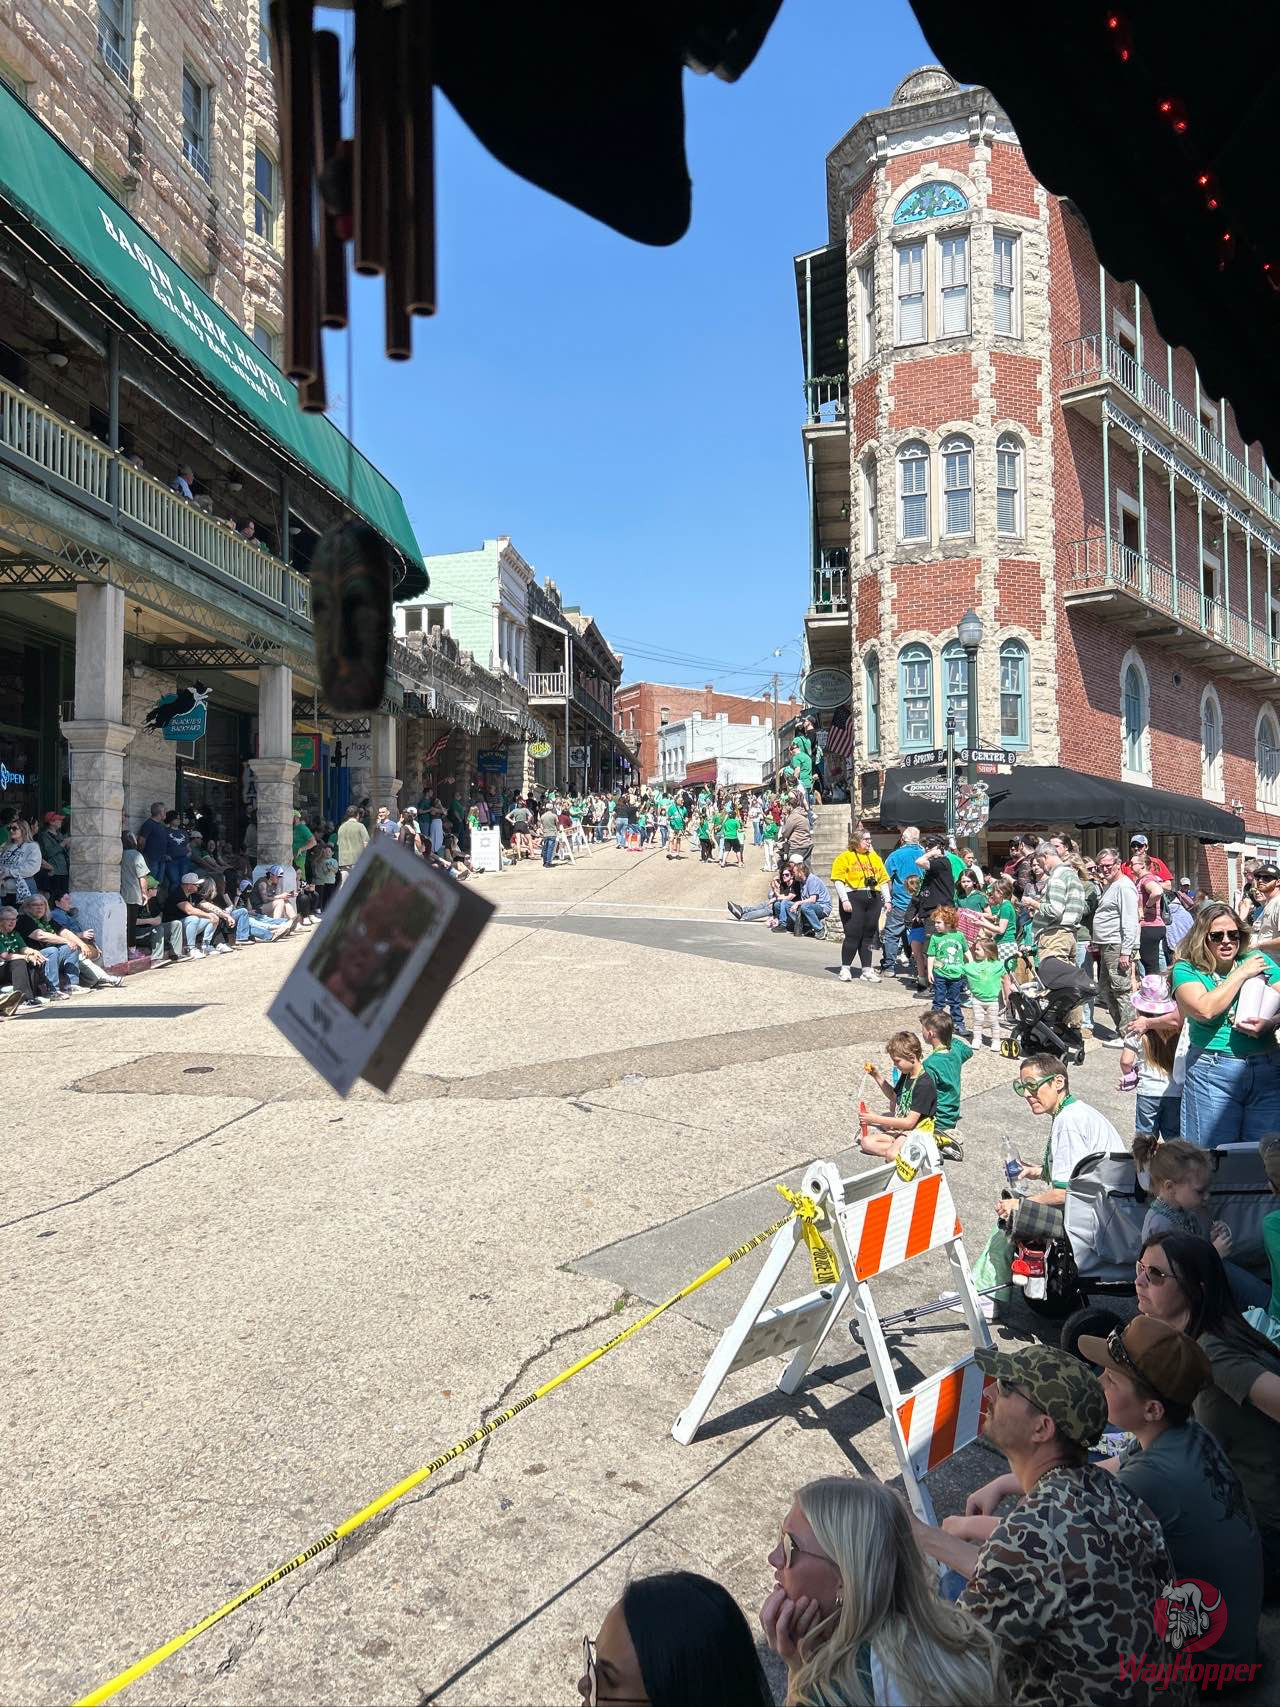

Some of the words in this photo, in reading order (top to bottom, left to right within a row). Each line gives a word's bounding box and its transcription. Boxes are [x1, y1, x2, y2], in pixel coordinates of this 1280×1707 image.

[98, 207, 174, 296] BASIN
[178, 286, 233, 354] PARK
[233, 341, 287, 406] HOTEL
[149, 277, 204, 343] Balcony
[205, 332, 269, 402] Restaurant
[913, 752, 936, 765] SPRING
[971, 750, 1006, 763] CENTER
